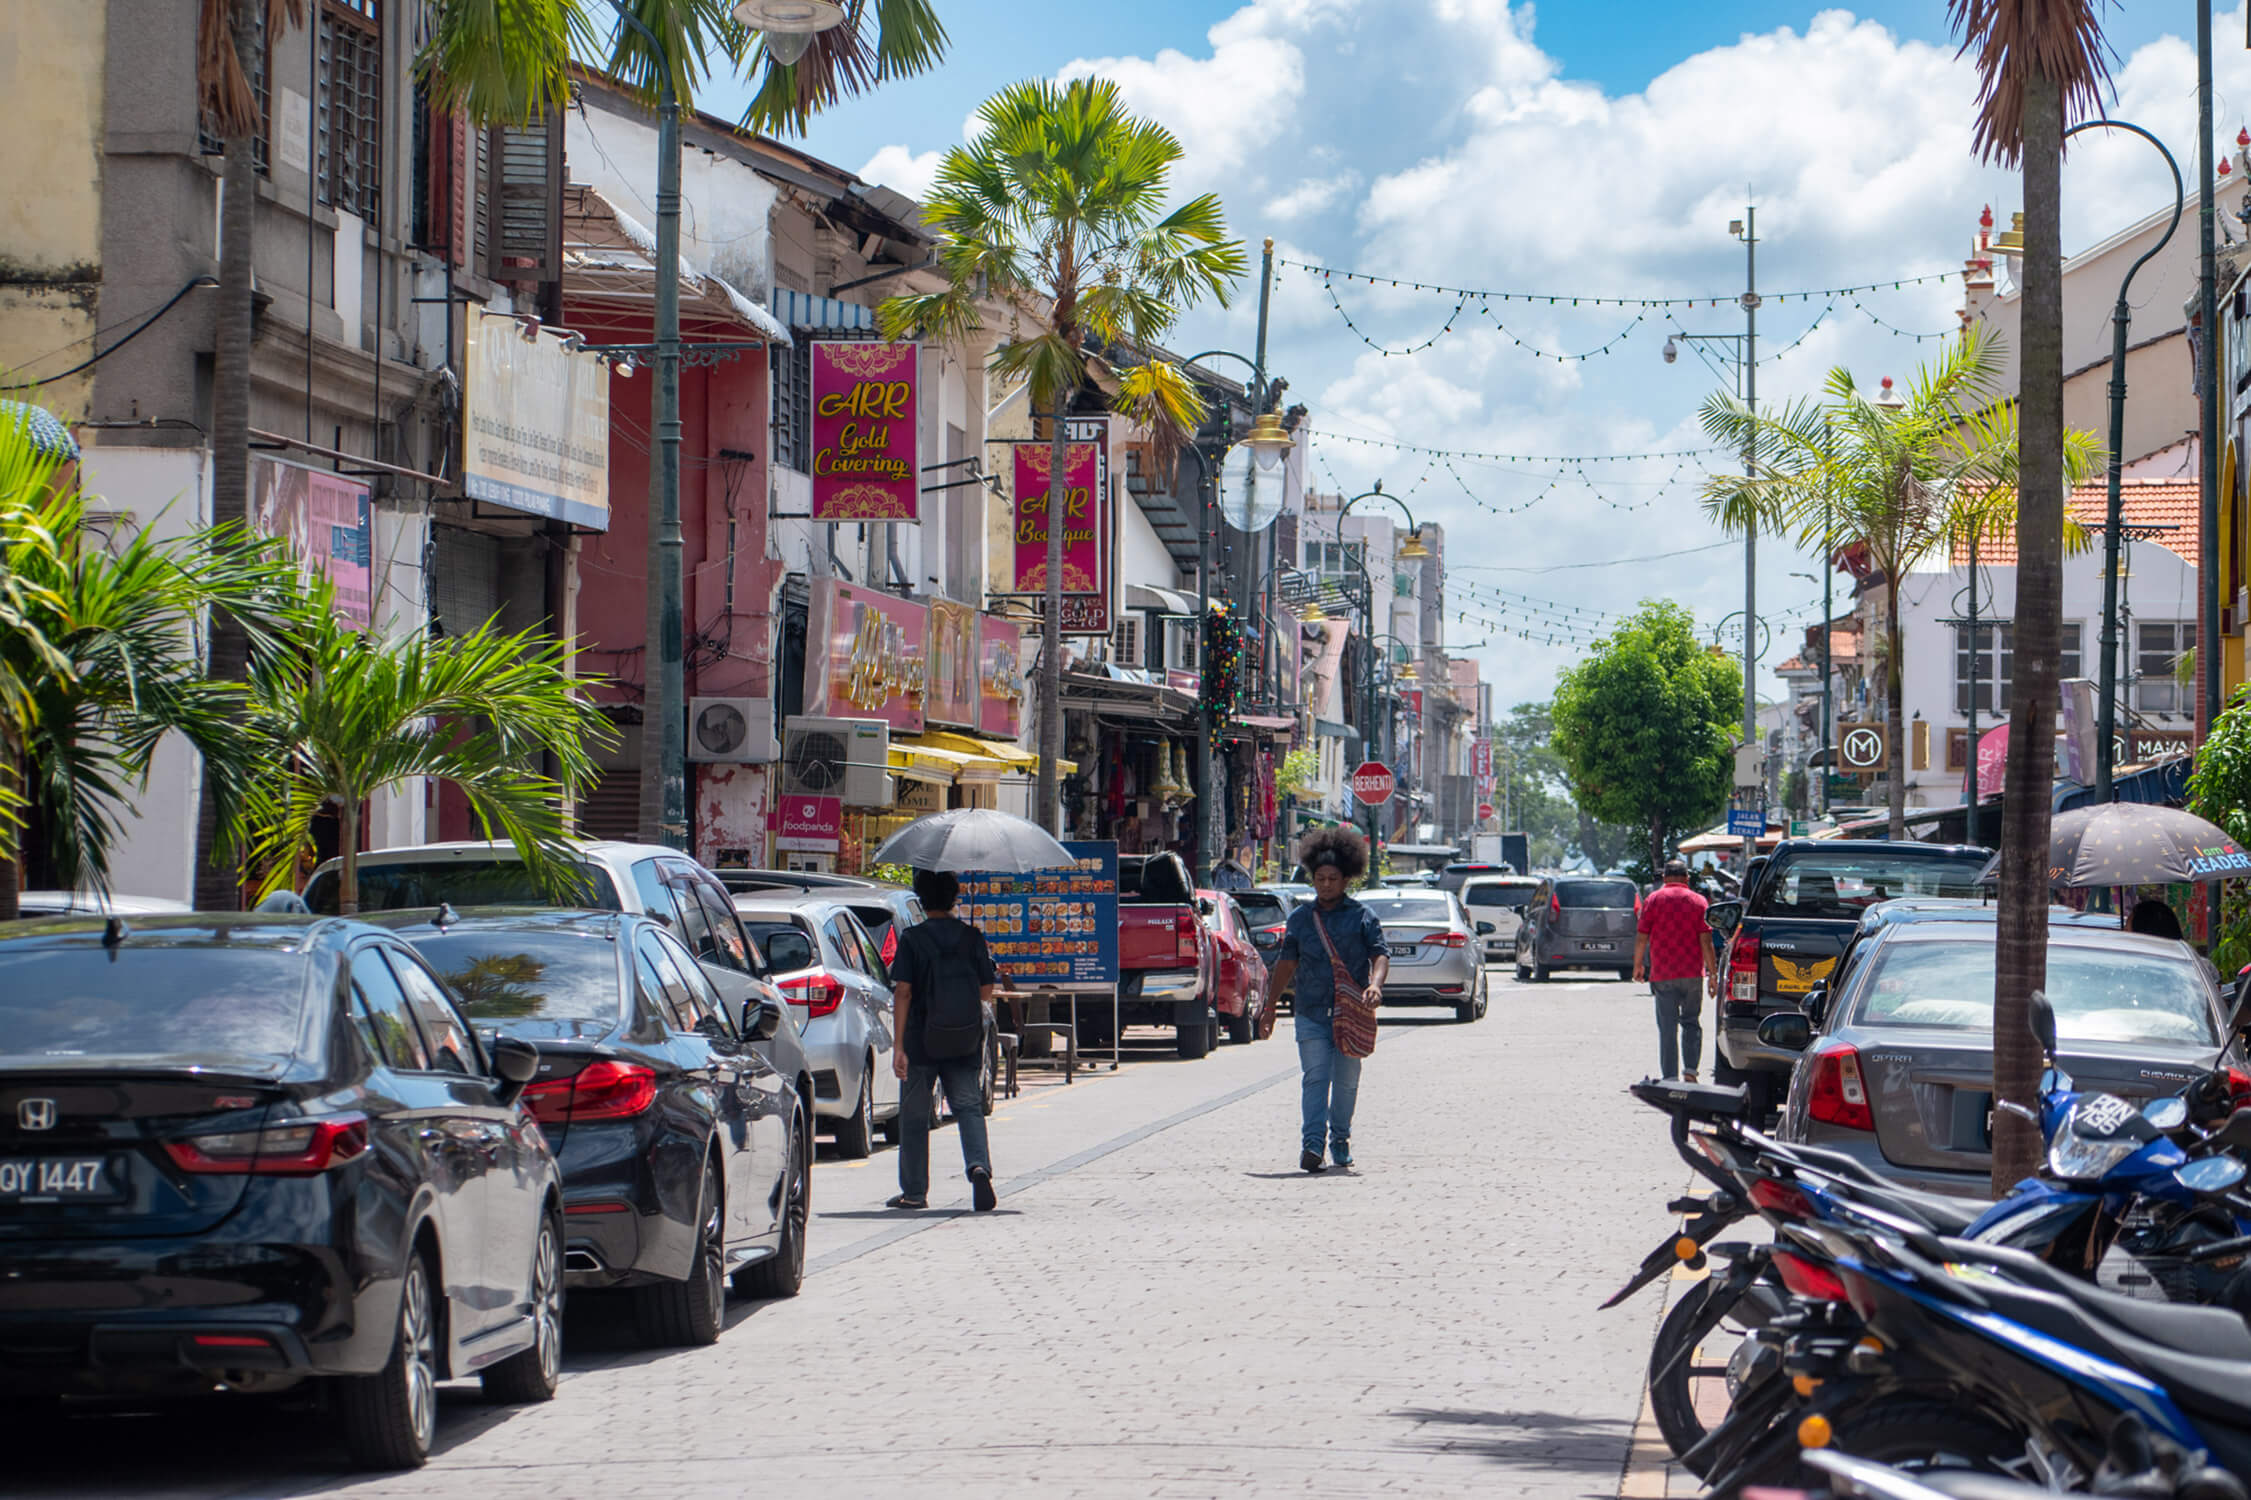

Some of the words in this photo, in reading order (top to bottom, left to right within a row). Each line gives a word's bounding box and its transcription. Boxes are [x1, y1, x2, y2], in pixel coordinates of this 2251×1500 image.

[818, 381, 911, 419] ARR
[840, 422, 889, 456] Gold
[815, 447, 912, 481] Covering
[1016, 519, 1093, 552] Bouque
[1061, 609, 1104, 619] GOLD
[1354, 775, 1393, 792] BERHENTI
[1736, 812, 1760, 820] JALAN
[783, 820, 833, 832] foodpanda
[2202, 847, 2225, 856] am
[2189, 853, 2251, 873] LEADER
[1765, 942, 1796, 950] TOYOTA
[1872, 1055, 1912, 1063] OPTRA
[38, 1161, 101, 1193] 1447
